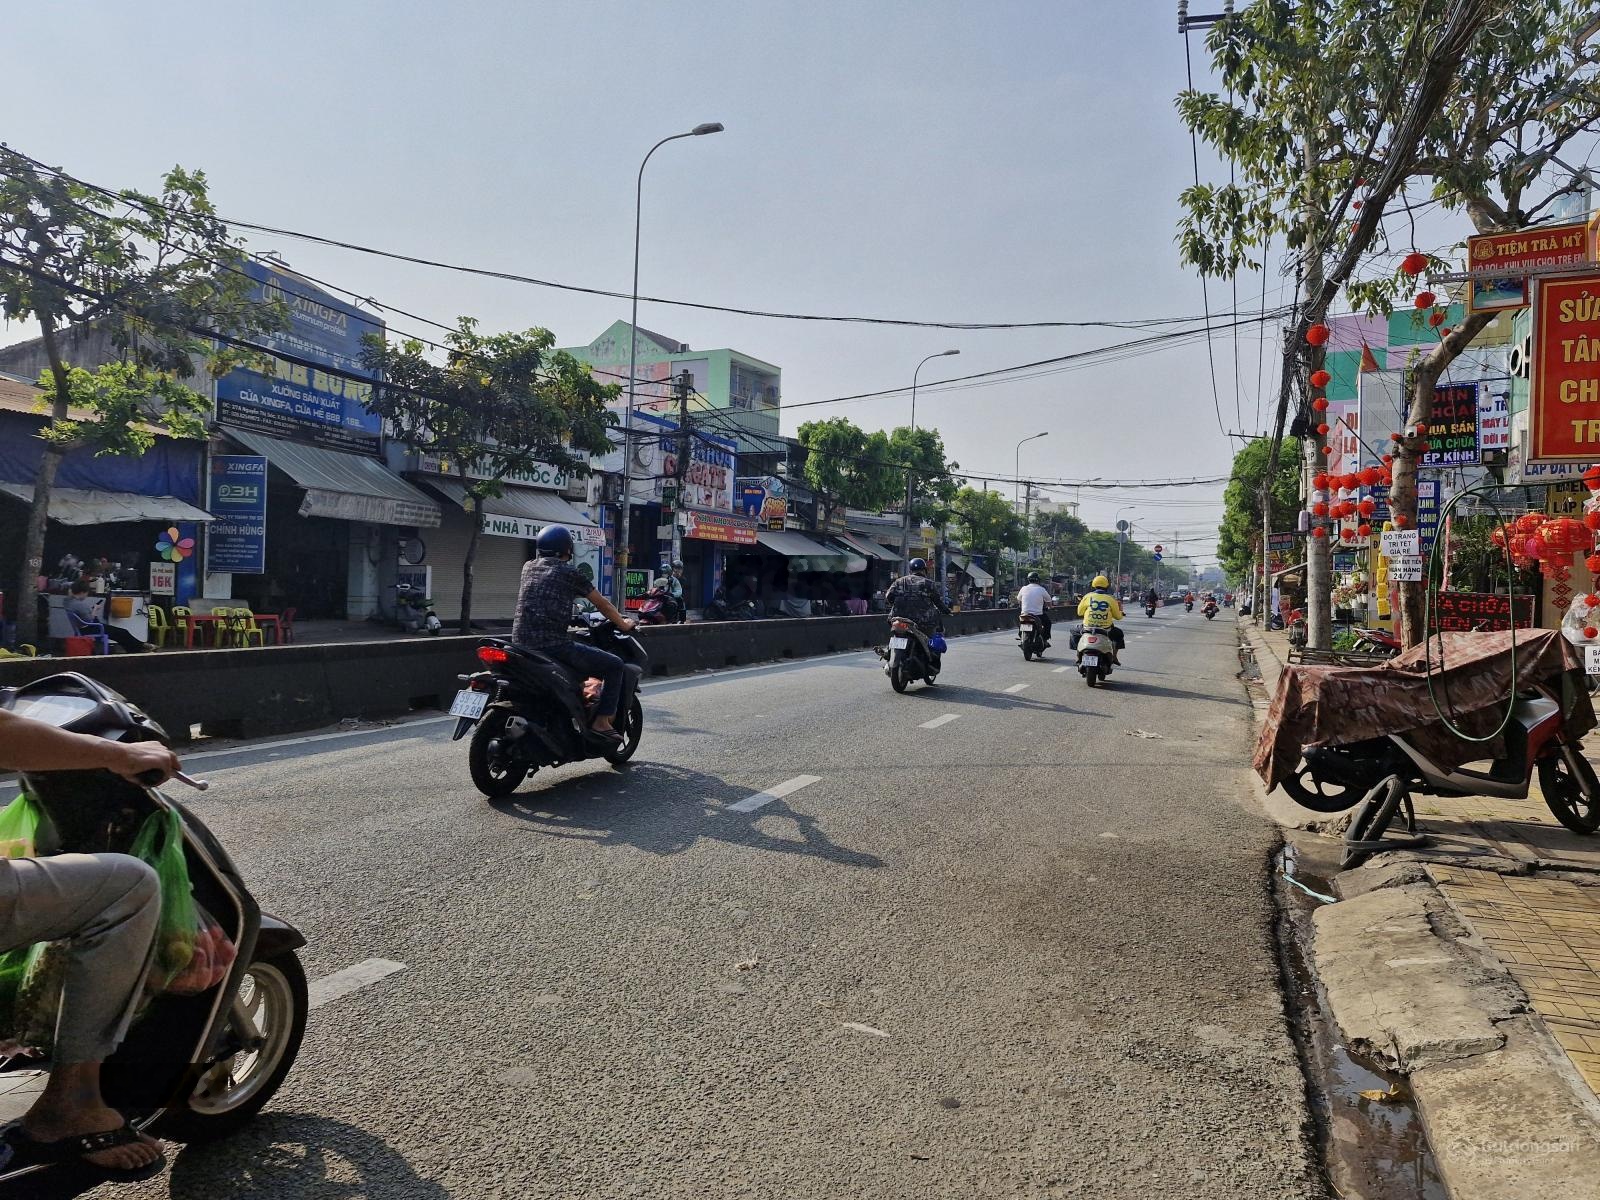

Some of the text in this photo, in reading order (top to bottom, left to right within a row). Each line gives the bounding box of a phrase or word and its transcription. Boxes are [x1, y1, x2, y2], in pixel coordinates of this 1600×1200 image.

[1497, 232, 1582, 256] TIỆM TRÀ MỸ
[1444, 449, 1475, 461] KÍNH
[227, 463, 264, 471] XINGFA
[210, 522, 237, 535] CHÍNH
[493, 519, 519, 535] NHÀ
[1395, 532, 1417, 540] TRANG
[152, 575, 173, 588] 16K
[1393, 572, 1412, 580] 24/7
[1090, 596, 1109, 611] be
